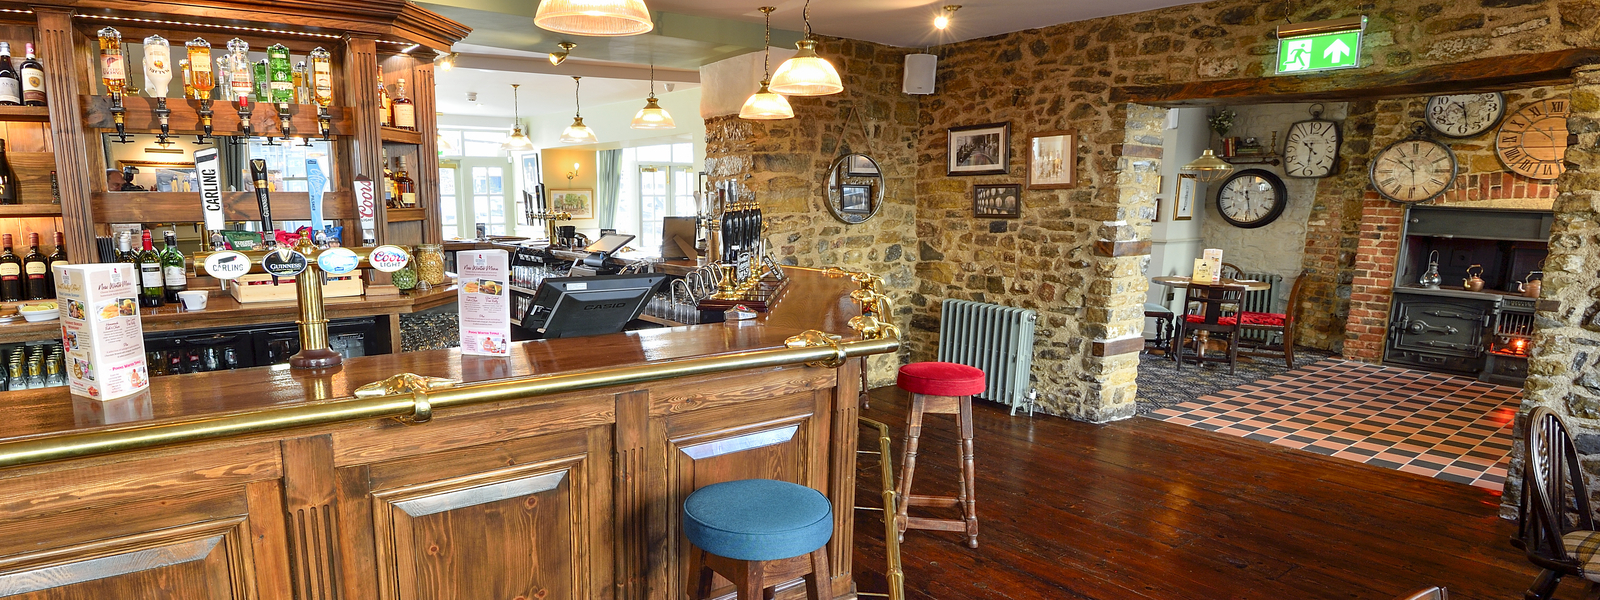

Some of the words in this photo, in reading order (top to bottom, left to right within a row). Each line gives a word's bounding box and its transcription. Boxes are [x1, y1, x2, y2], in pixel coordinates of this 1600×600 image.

[1438, 96, 1449, 105] 10
[1488, 103, 1497, 112] 3
[1551, 101, 1564, 113] XII
[1309, 122, 1322, 134] 12
[1446, 123, 1455, 131] 7
[1458, 124, 1467, 134] 6
[1288, 133, 1301, 144] 10
[1302, 166, 1313, 177] 6
[201, 168, 221, 212] CARLING
[358, 180, 374, 219] Coors
[374, 250, 406, 262] Coors
[212, 263, 244, 272] CARLING
[269, 262, 302, 270] GUINNESS
[583, 302, 626, 311] CASIO
